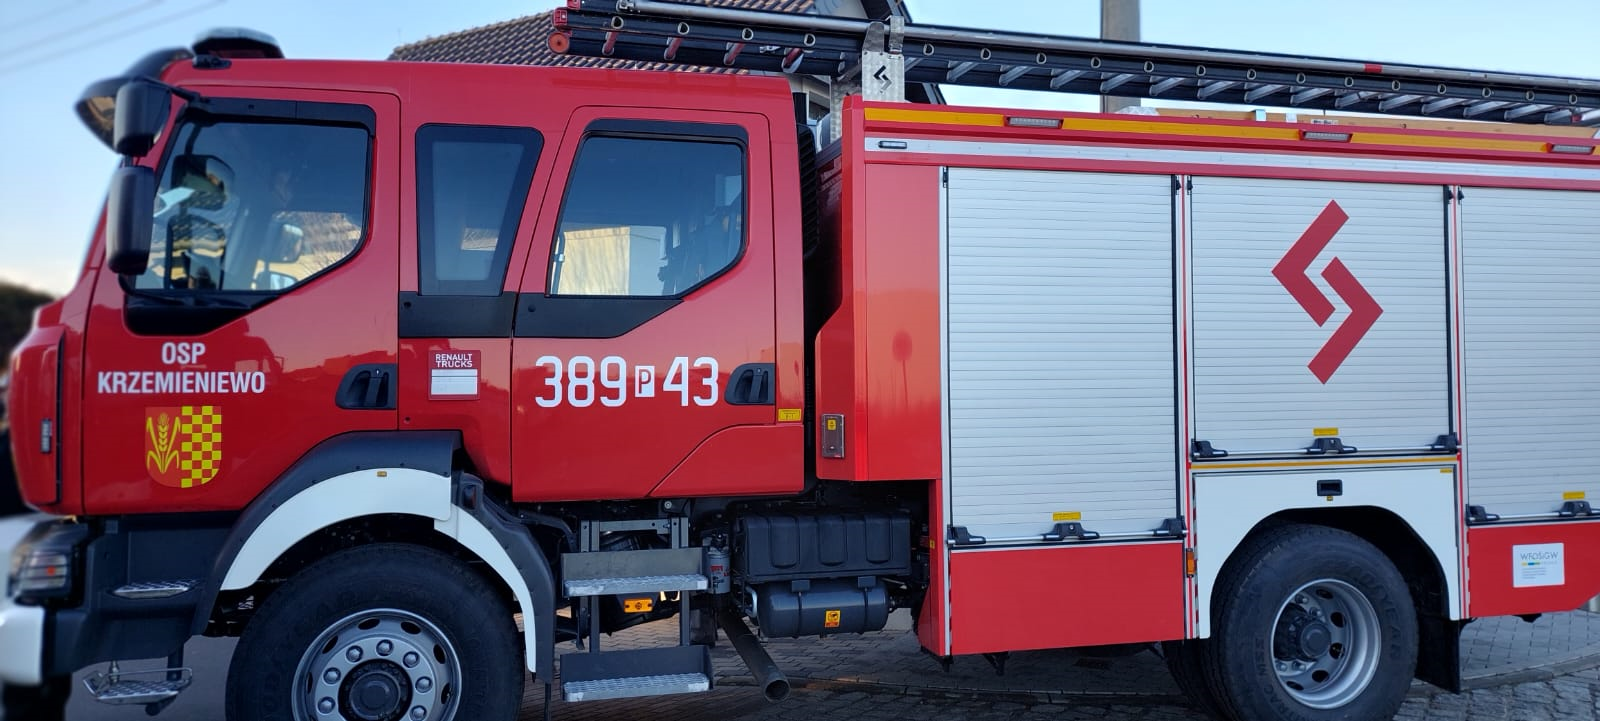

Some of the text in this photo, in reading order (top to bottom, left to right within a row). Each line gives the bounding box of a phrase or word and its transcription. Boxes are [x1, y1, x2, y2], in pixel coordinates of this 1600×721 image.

[161, 341, 206, 365] OSP
[435, 353, 473, 361] RENAULT
[97, 371, 266, 394] KRZEMIENIEWO
[535, 355, 719, 408] 389 P 43
